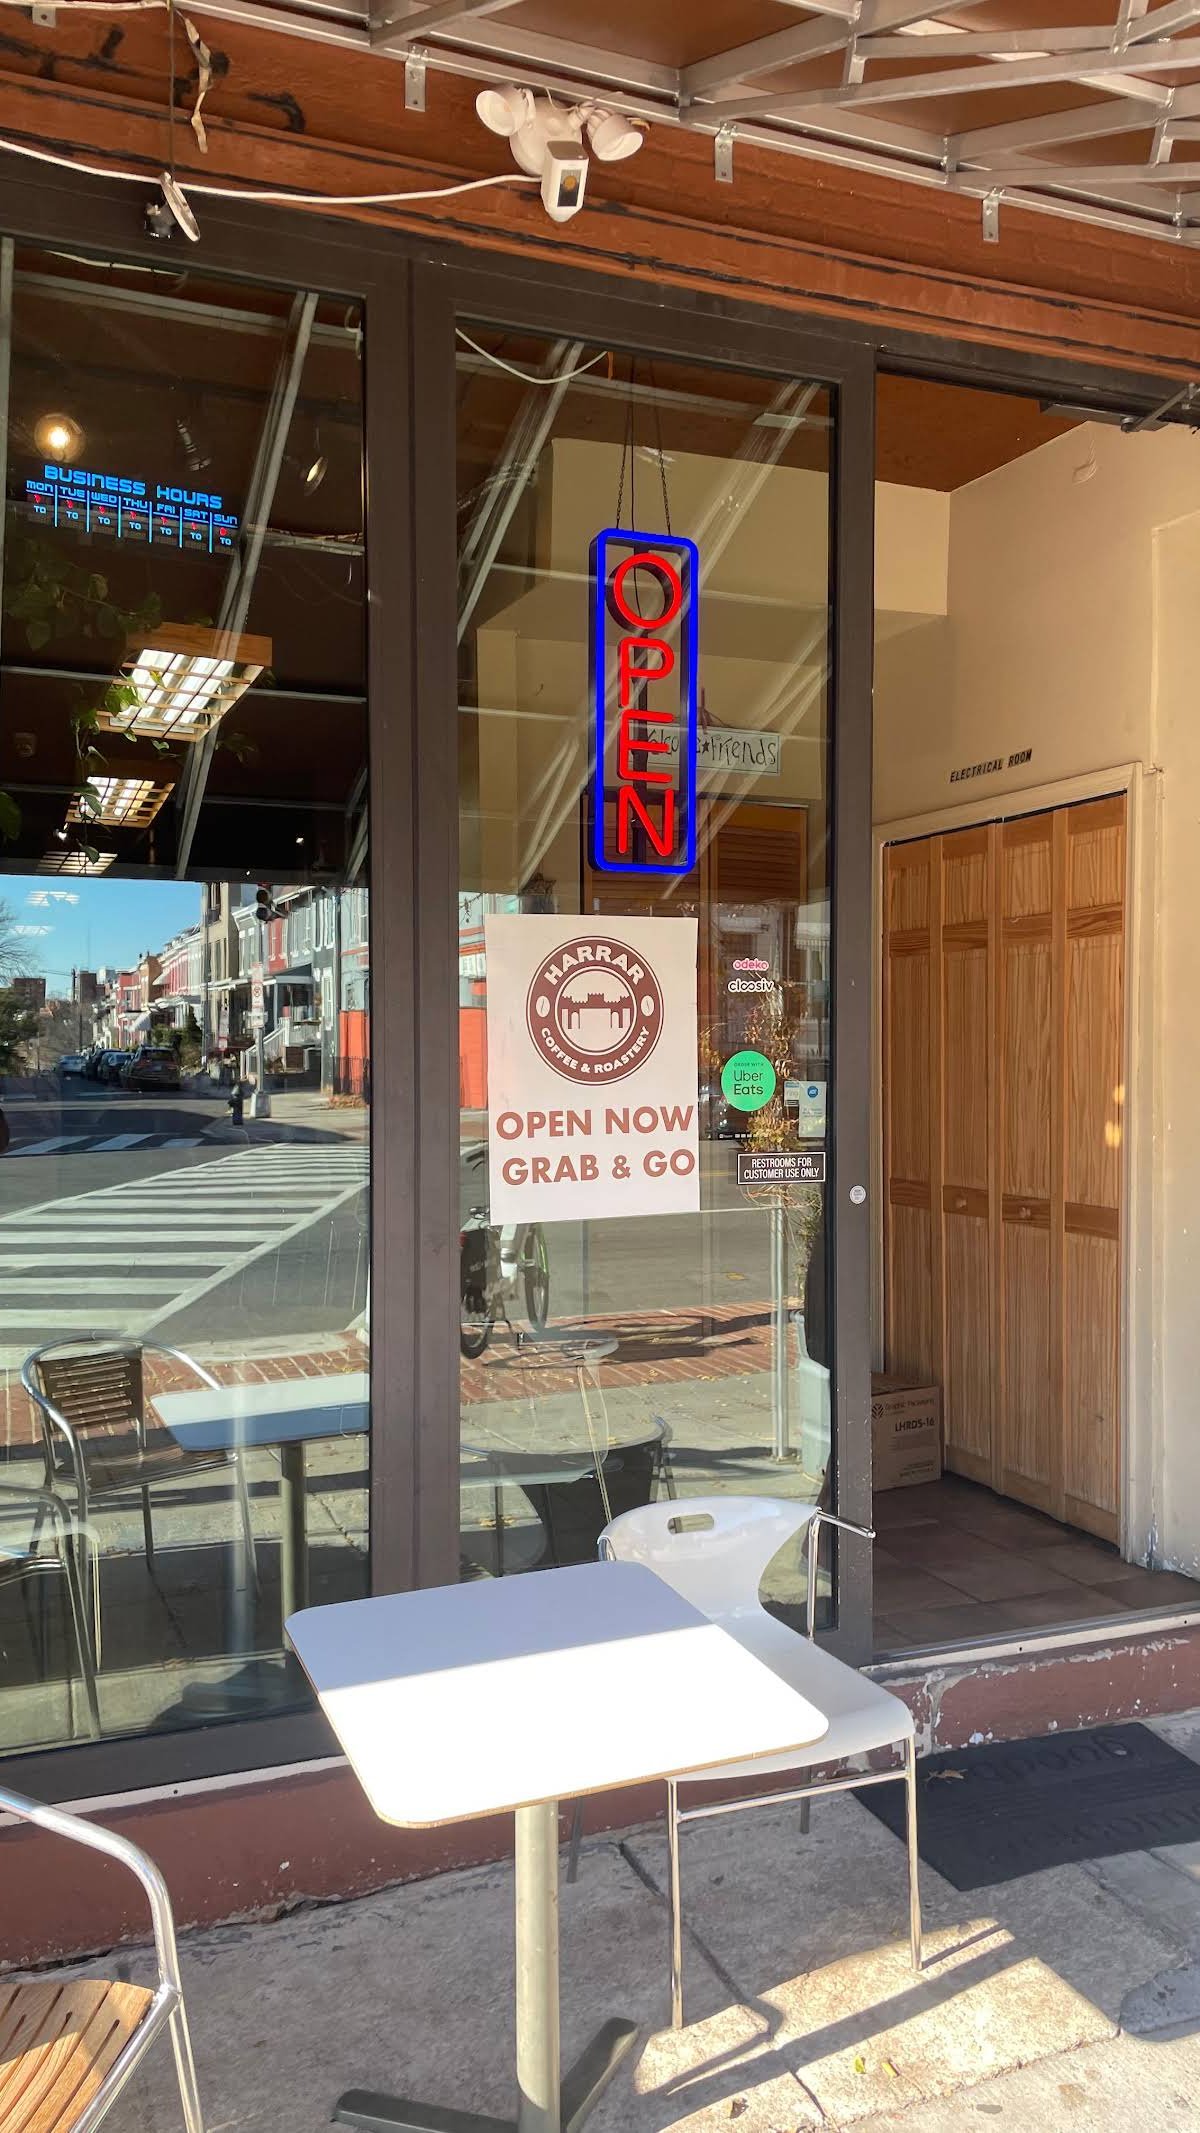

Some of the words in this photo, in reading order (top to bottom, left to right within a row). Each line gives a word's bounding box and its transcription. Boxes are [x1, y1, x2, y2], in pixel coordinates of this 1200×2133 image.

[26, 480, 53, 492] MON
[60, 486, 85, 498] TUE
[91, 491, 117, 504] WED
[123, 498, 148, 509] THU
[156, 503, 176, 514] FRI
[184, 508, 208, 519] SAT
[213, 514, 238, 525] SUN
[44, 465, 146, 495] BUSINESS
[156, 485, 222, 509] HOURS
[33, 505, 47, 514] TO
[66, 511, 79, 519] TO
[98, 516, 111, 525] TO
[129, 521, 142, 530] TO
[160, 527, 172, 535] TO
[190, 532, 202, 541] TO
[219, 537, 232, 546] TO
[613, 552, 682, 857] OPEN
[949, 758, 1003, 783] ELECTRICAL
[1007, 748, 1033, 769] ROOM
[543, 945, 646, 986] HARRAR
[733, 958, 768, 970] odeko
[541, 1027, 579, 1070] COFFEE
[580, 1063, 591, 1074] &
[594, 1026, 650, 1074] ROASTERY
[733, 1070, 764, 1081] Uber
[733, 1084, 764, 1095] Eats
[496, 1108, 592, 1141] OPEN
[605, 1104, 694, 1135] NOW
[502, 1154, 600, 1186] GRAB
[611, 1154, 632, 1181] &
[642, 1148, 696, 1178] GO
[743, 1169, 784, 1179] CUSTOMER
[785, 1168, 800, 1178] USE
[801, 1168, 820, 1178] ONLY
[751, 1157, 796, 1169] RESTROOMS
[797, 1157, 812, 1167] FOR
